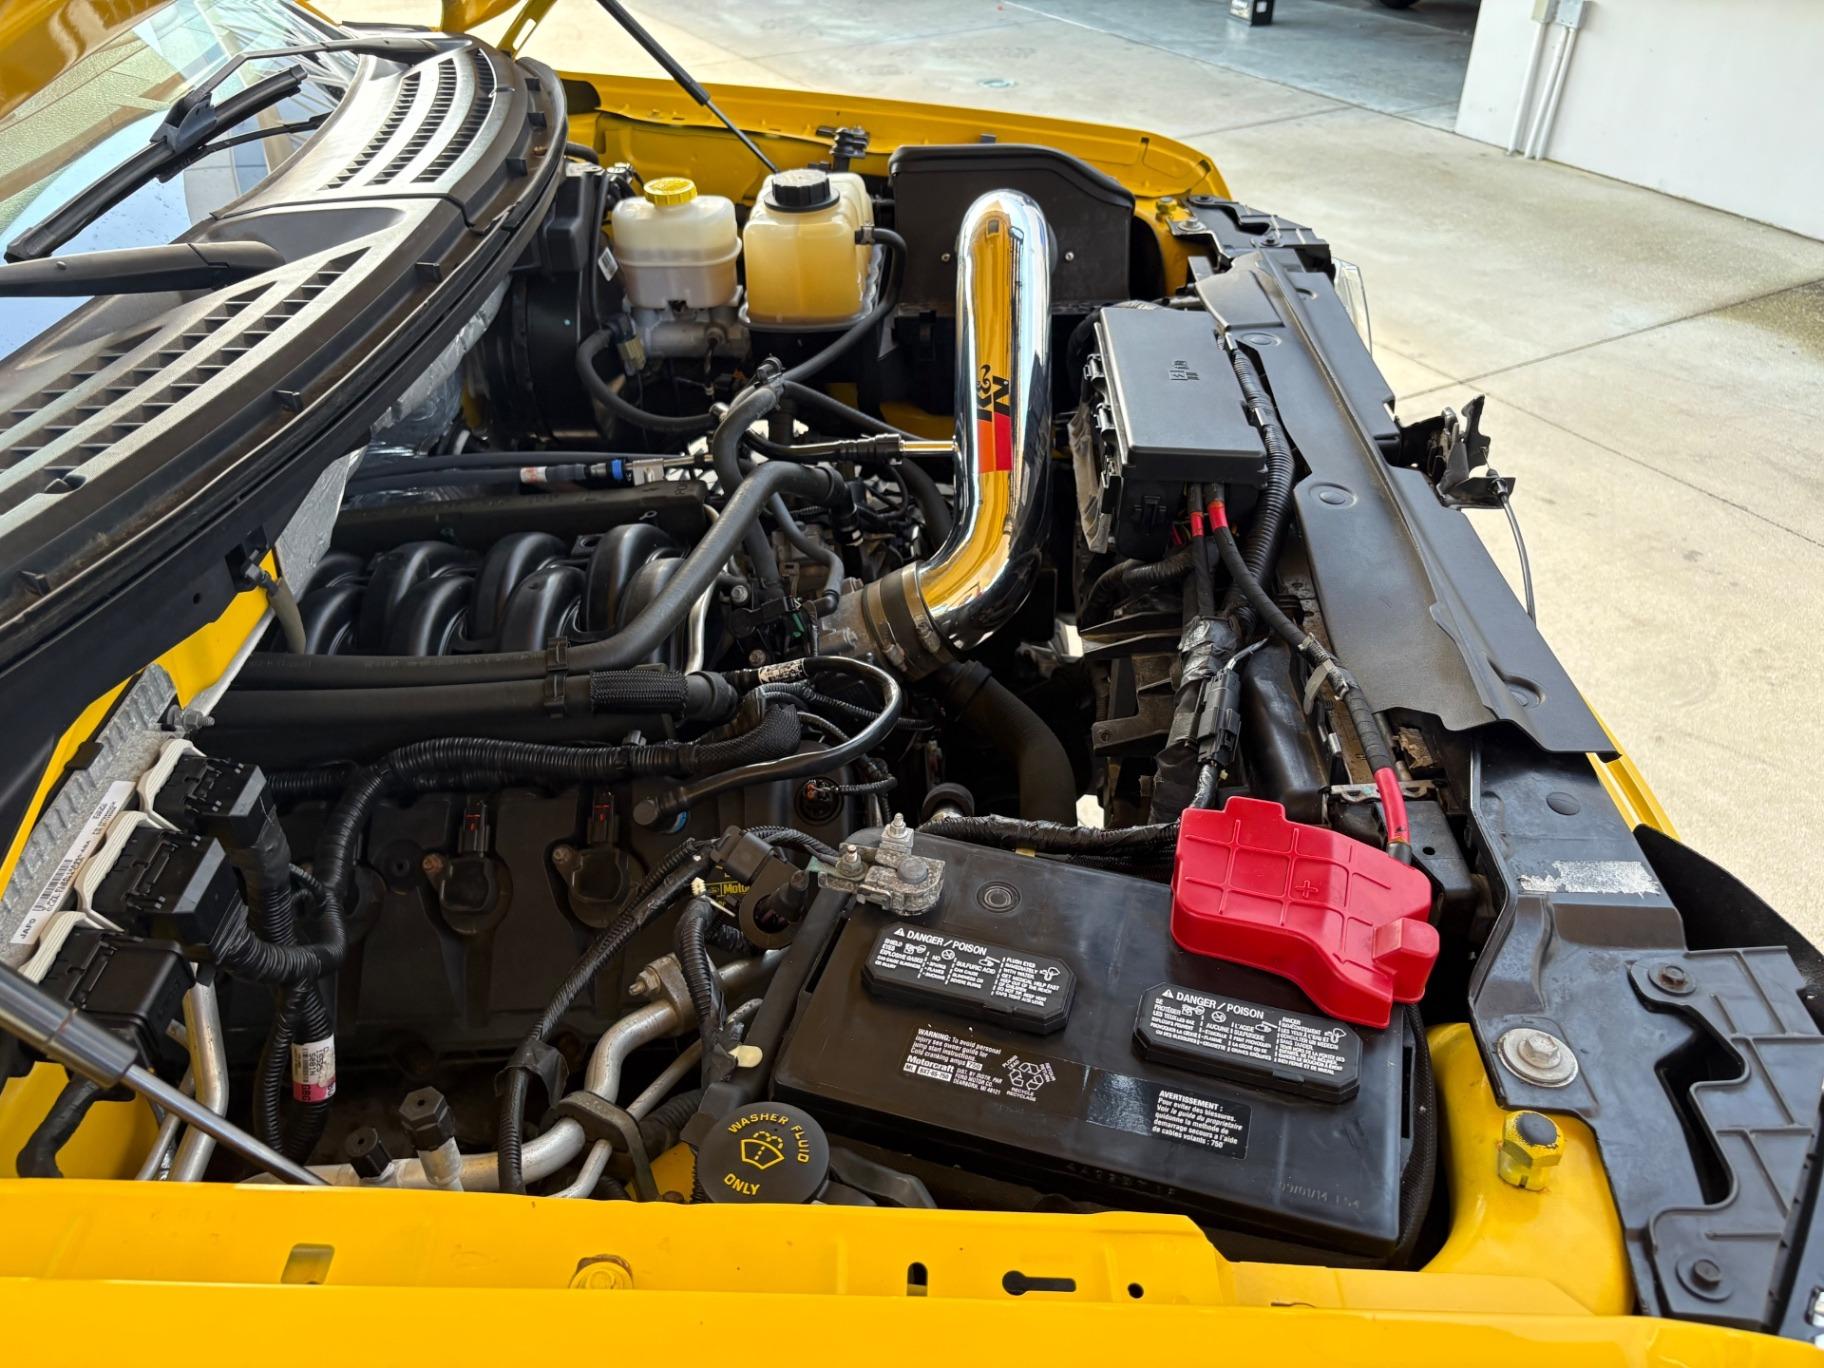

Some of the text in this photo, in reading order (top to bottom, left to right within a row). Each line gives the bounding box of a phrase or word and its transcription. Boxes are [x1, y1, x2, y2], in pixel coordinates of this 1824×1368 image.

[907, 930, 987, 956] DANGER POISON
[1176, 992, 1265, 1020] DANGER POISON
[908, 1055, 955, 1072] Motorcraft
[1159, 1090, 1220, 1111] AVERTISSEMENT
[728, 1113, 810, 1163] WASHER FLUID
[723, 1173, 761, 1195] ONLY
